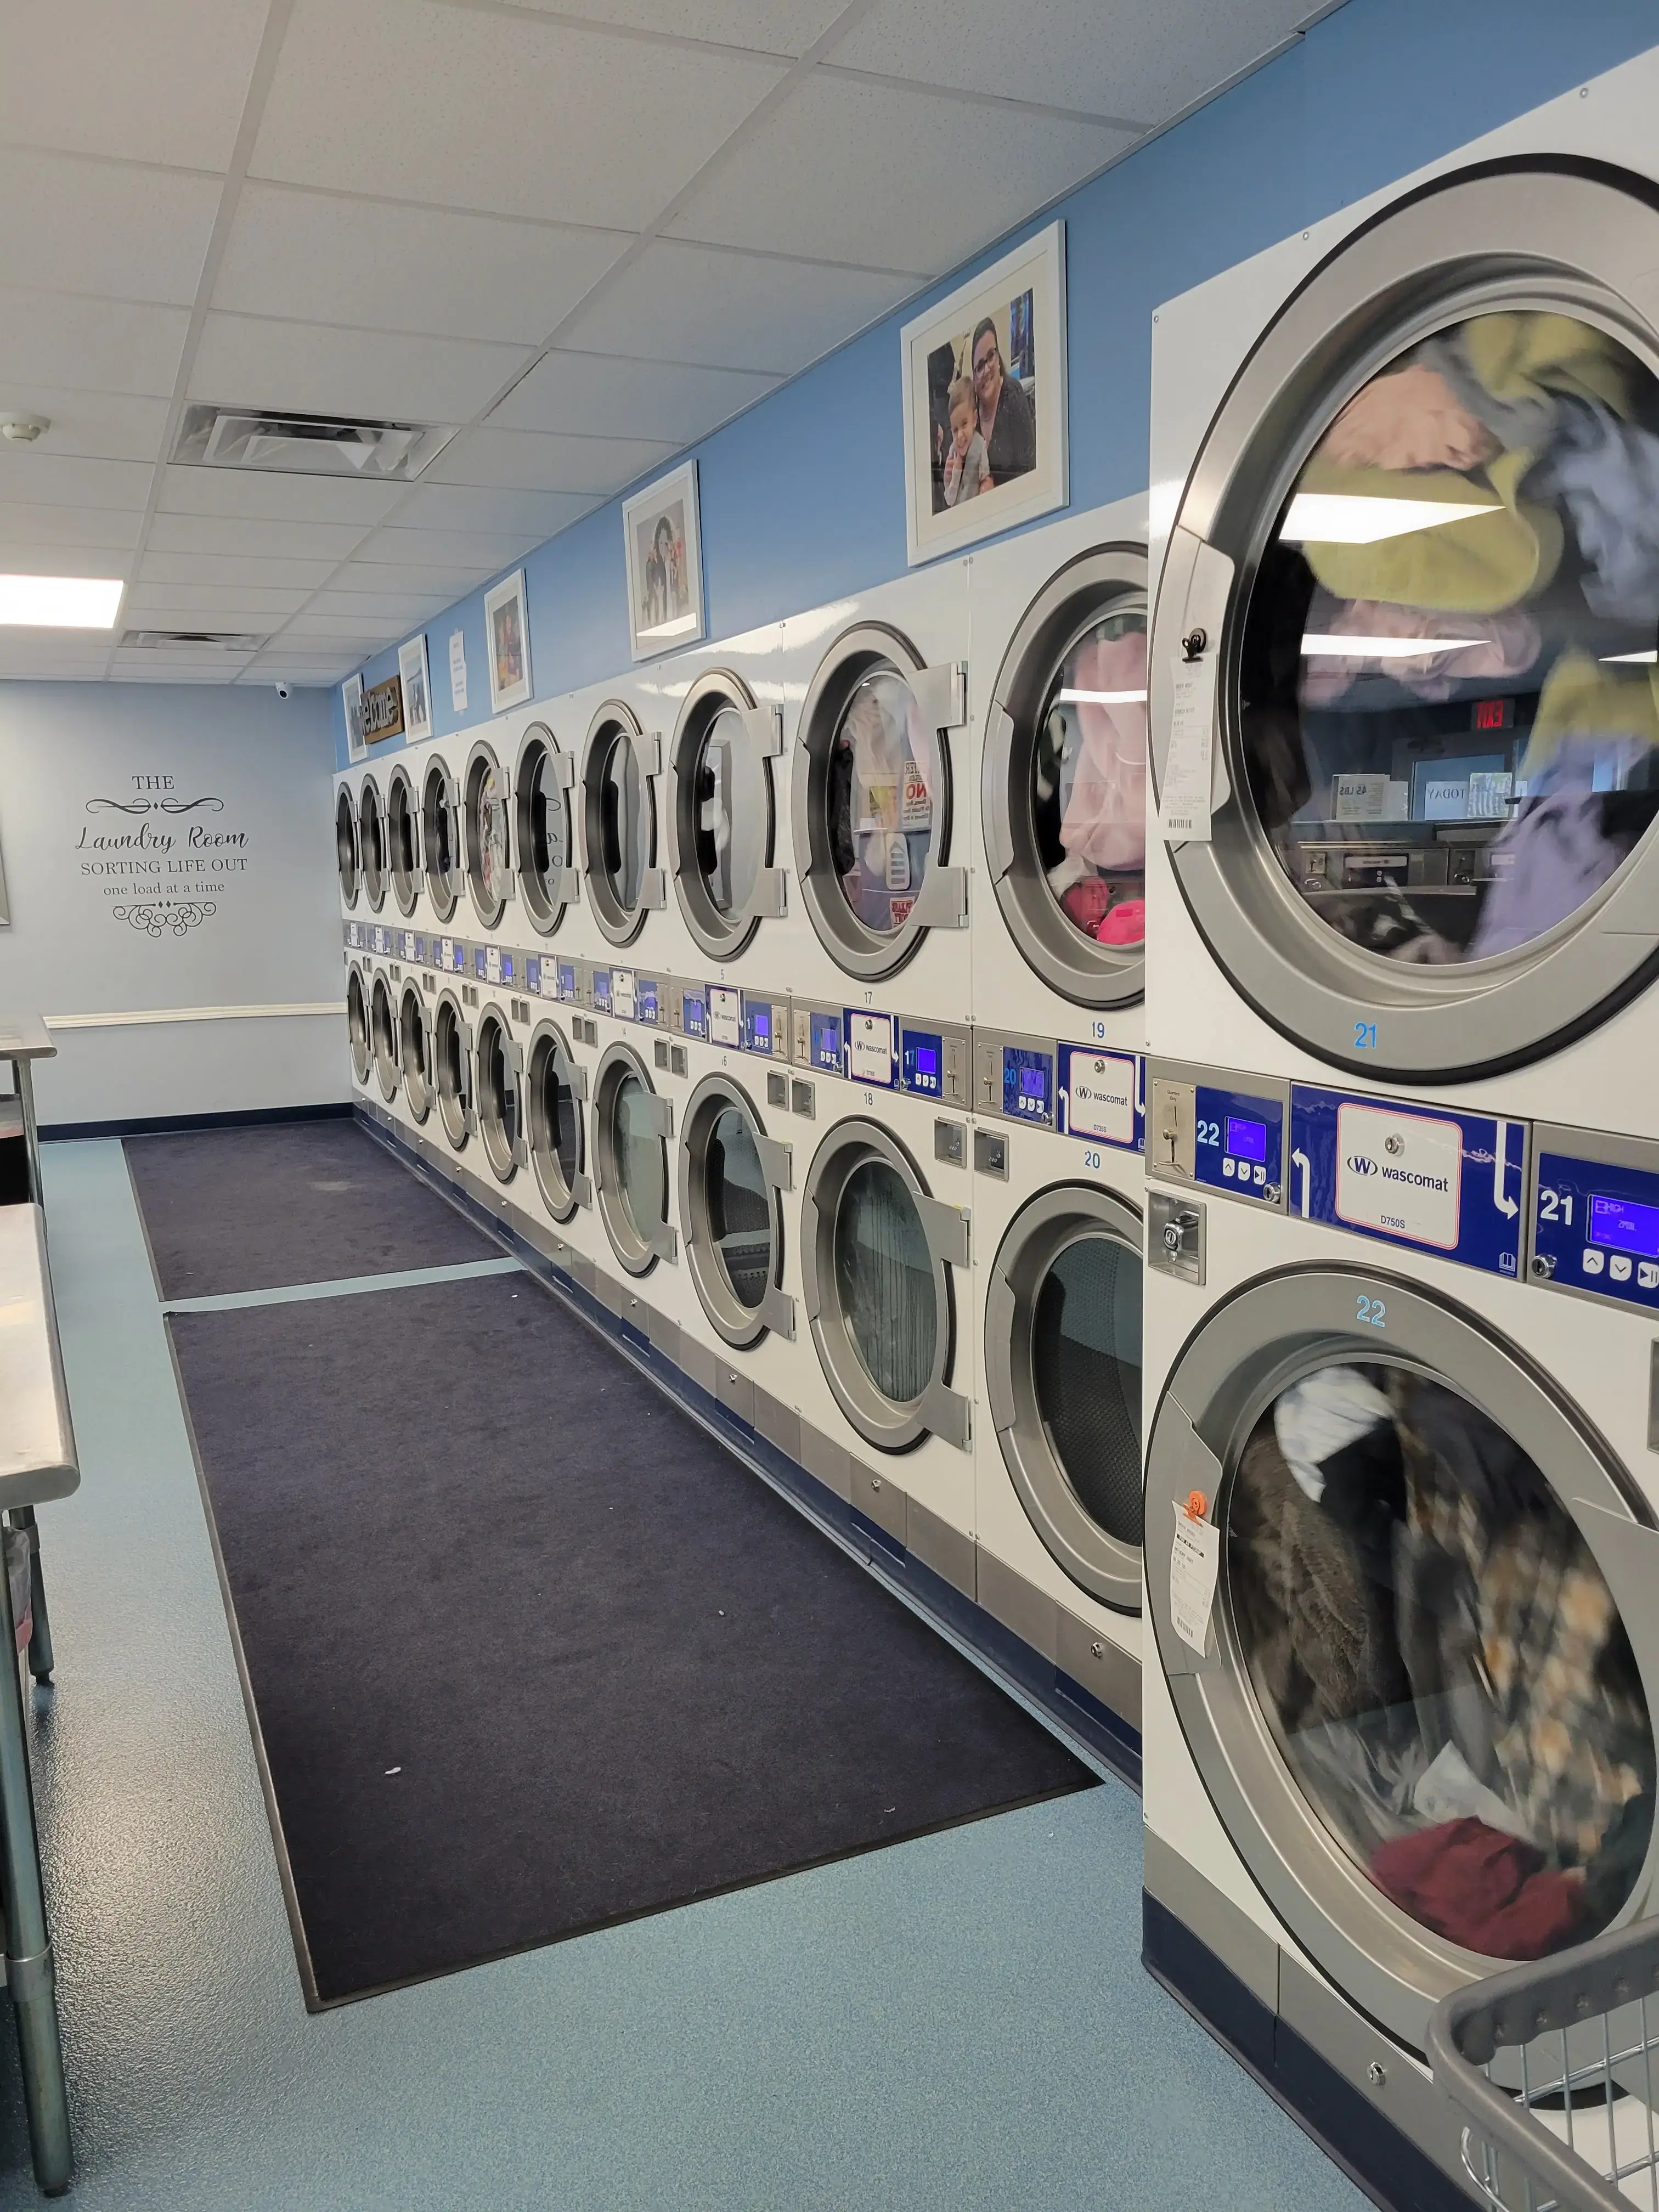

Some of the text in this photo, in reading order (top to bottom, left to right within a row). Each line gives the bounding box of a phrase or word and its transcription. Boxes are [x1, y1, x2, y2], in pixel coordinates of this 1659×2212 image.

[132, 776, 174, 789] THE
[75, 823, 249, 854] Laundry Room
[81, 859, 248, 876] SORTING LIFE OUT
[104, 887, 128, 895] one
[133, 883, 161, 895] load
[166, 884, 179, 893] at
[195, 882, 225, 892] time
[864, 991, 872, 1005] 17
[1092, 1022, 1105, 1039] 19
[1354, 1022, 1376, 1049] 21
[866, 1045, 887, 1055] wascomat
[905, 1049, 915, 1065] 17
[1004, 1068, 1017, 1085] 20
[864, 1092, 873, 1105] 18
[1093, 1091, 1128, 1107] wascomat
[1093, 1124, 1107, 1133] D735S
[1197, 1120, 1220, 1147] 22
[1085, 1150, 1101, 1169] 20
[1381, 1166, 1448, 1192] wascomat
[1540, 1189, 1573, 1226] 21
[1380, 1215, 1406, 1229] D750S
[1356, 1295, 1385, 1328] 22
